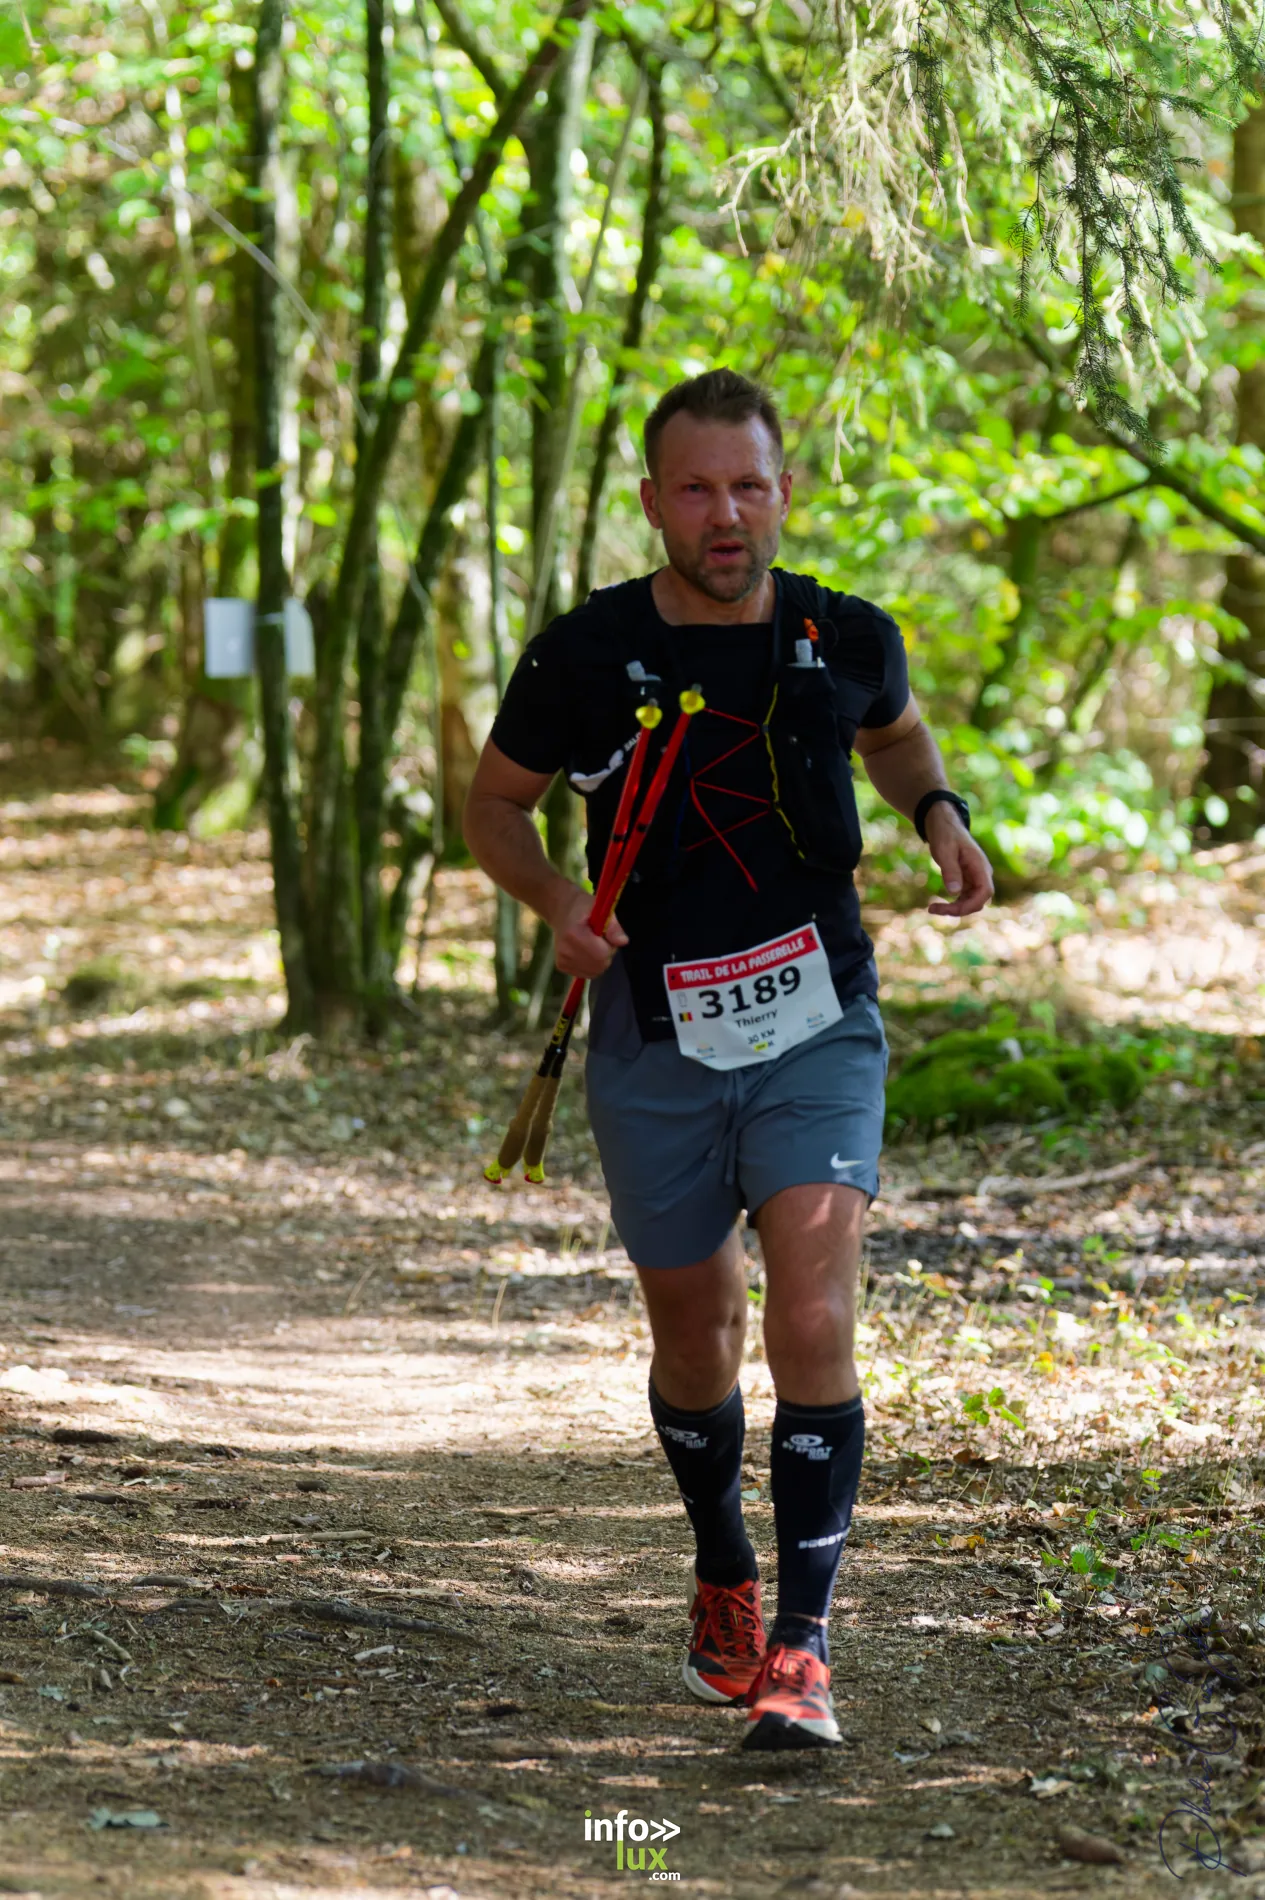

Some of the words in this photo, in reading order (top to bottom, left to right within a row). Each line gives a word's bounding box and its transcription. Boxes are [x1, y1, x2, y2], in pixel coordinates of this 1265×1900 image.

[680, 967, 713, 984] TRAIL
[714, 963, 729, 978] DE
[731, 961, 747, 974] LA
[748, 937, 806, 970] PASSERELLE
[698, 965, 802, 1019] 3189
[735, 1009, 778, 1029] Thierry
[760, 1028, 776, 1040] KM
